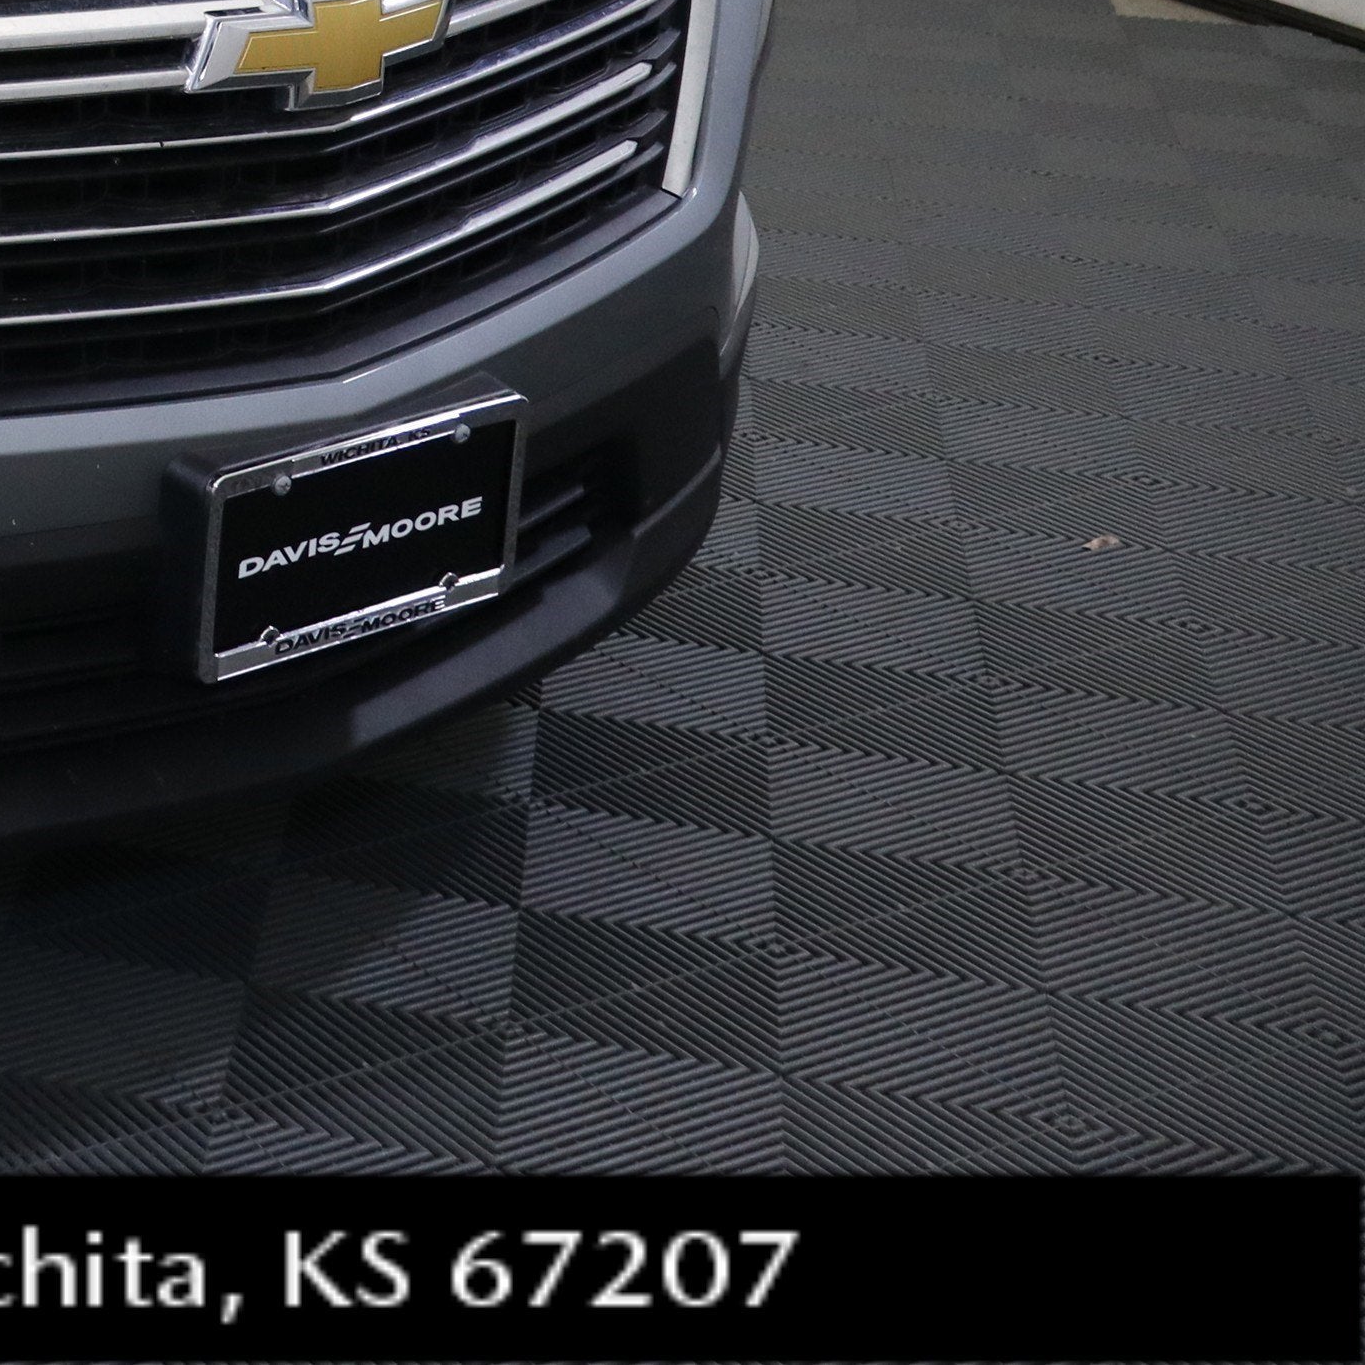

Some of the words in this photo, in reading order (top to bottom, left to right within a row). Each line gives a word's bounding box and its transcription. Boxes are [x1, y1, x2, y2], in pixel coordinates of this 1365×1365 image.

[237, 532, 341, 579] DAVIS
[364, 496, 483, 549] MOORE
[275, 623, 347, 654] DAVIS
[361, 595, 446, 634] MOORE
